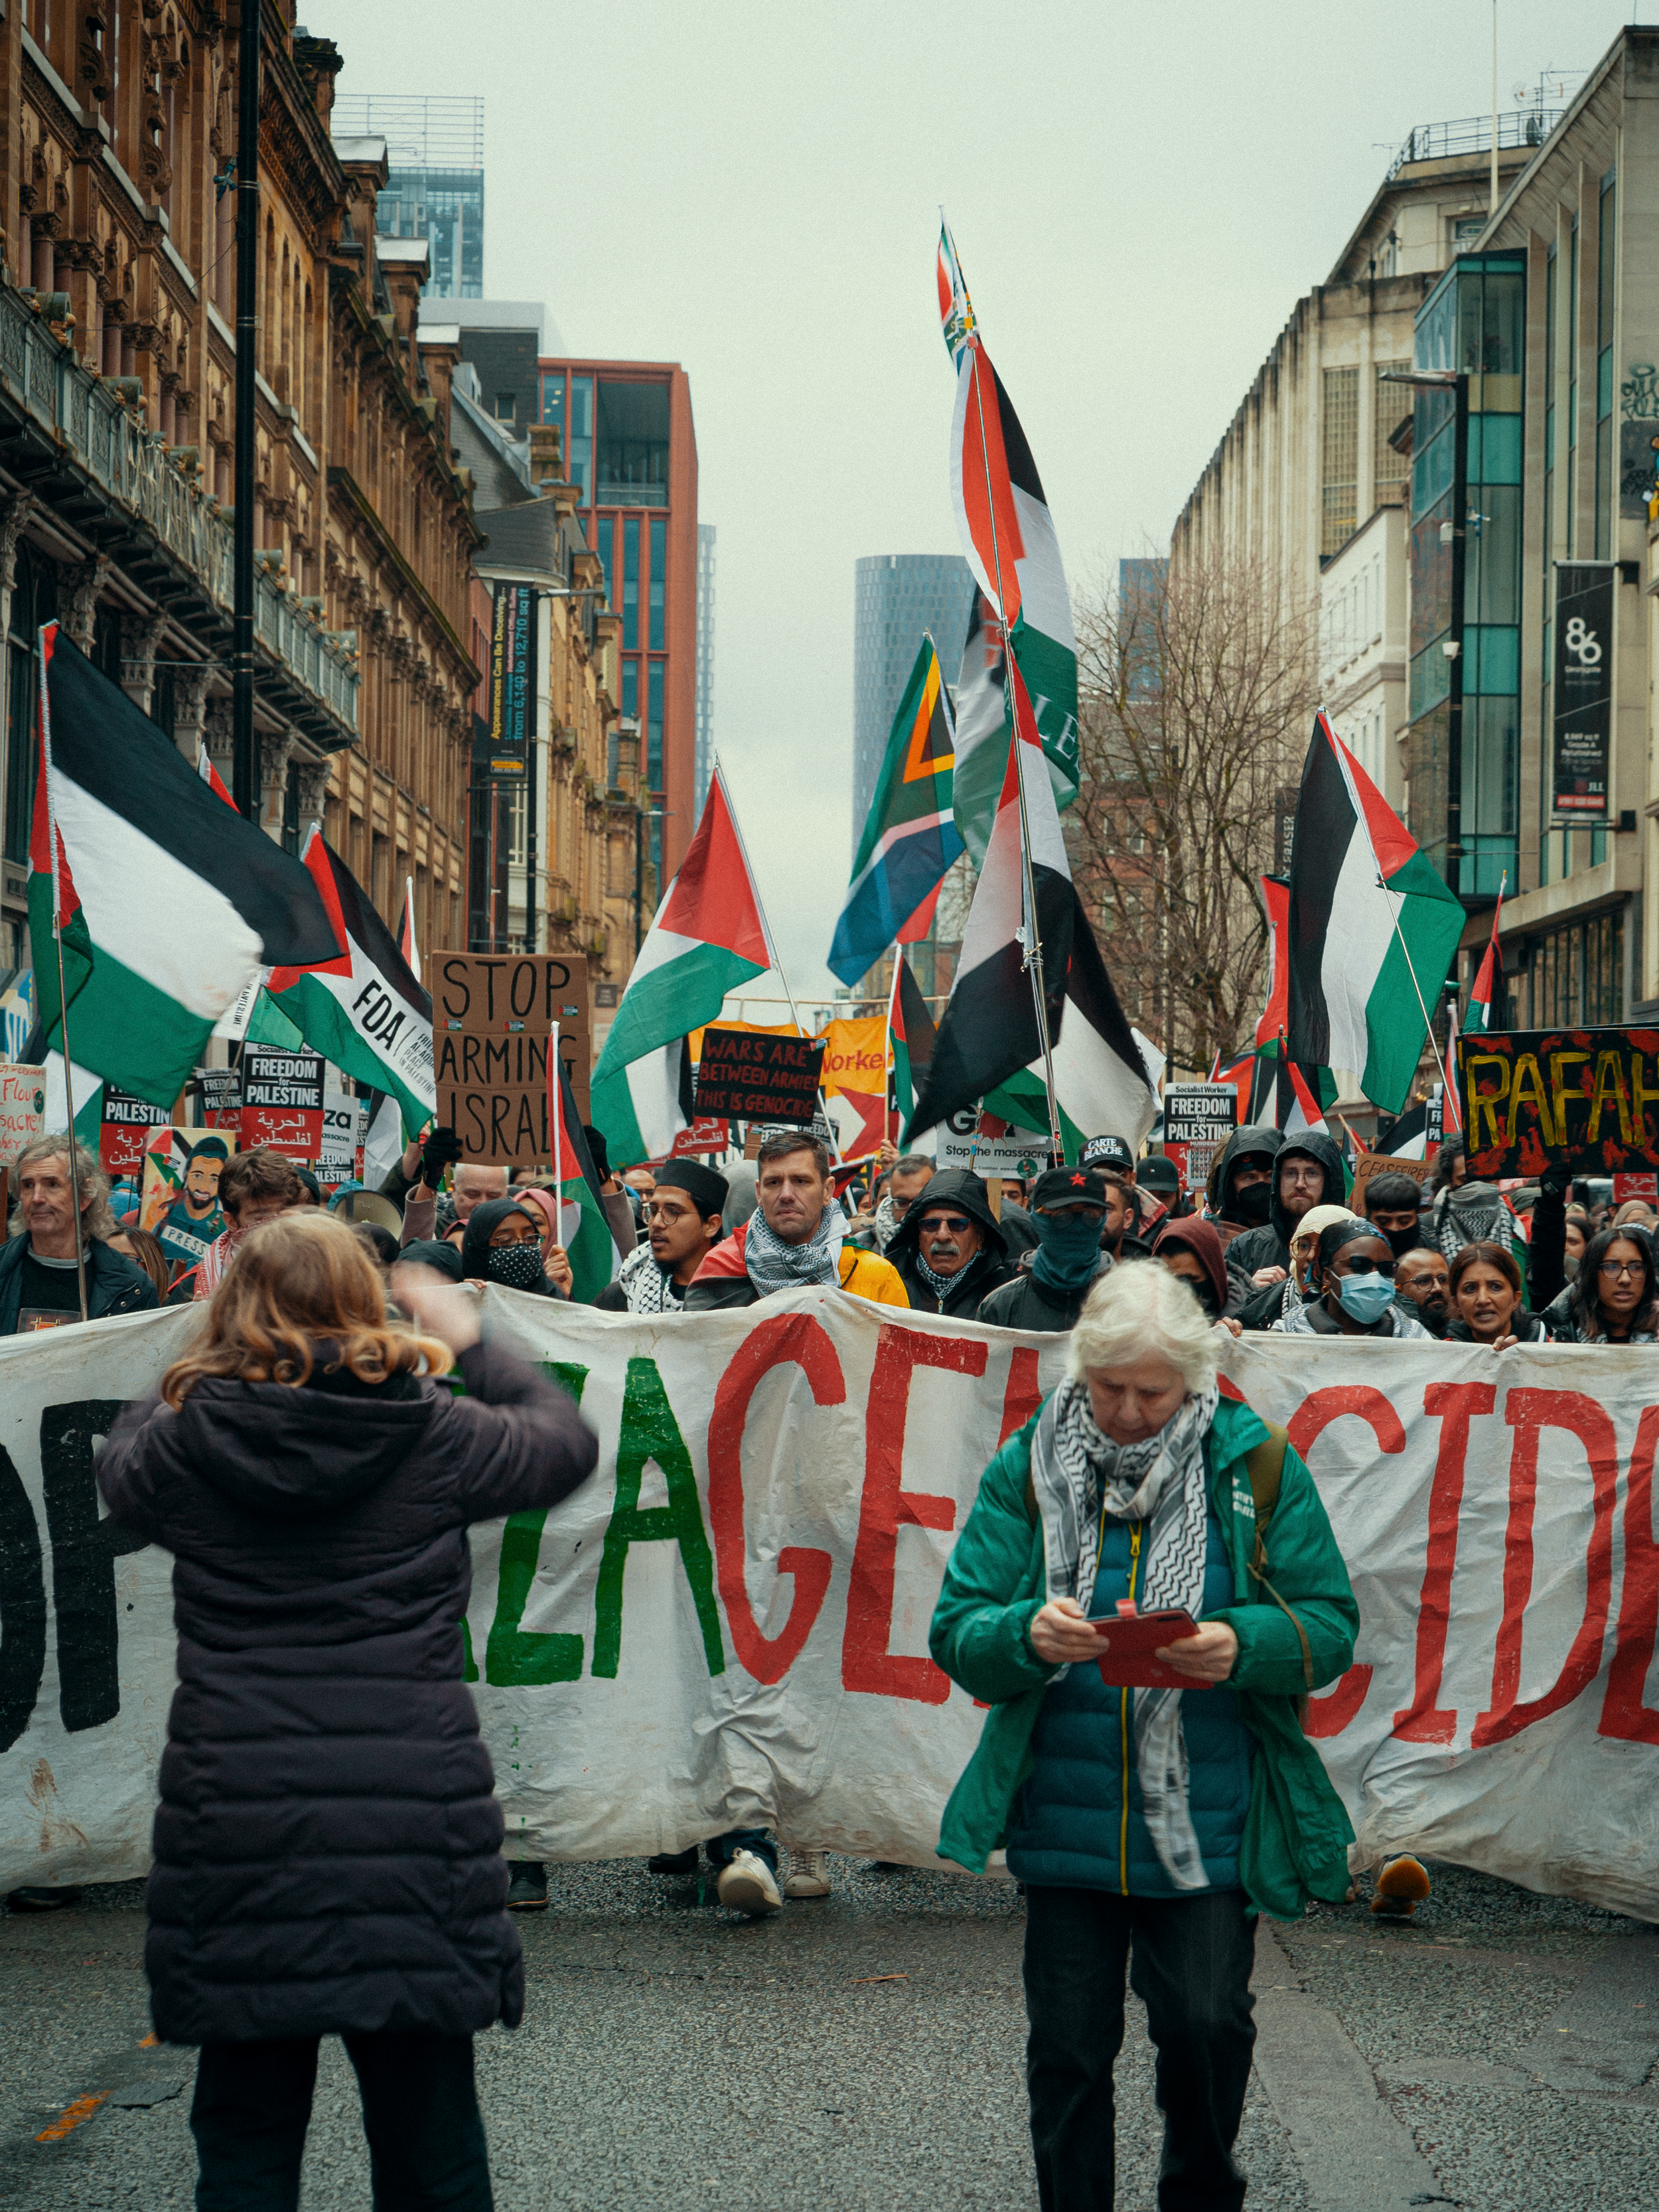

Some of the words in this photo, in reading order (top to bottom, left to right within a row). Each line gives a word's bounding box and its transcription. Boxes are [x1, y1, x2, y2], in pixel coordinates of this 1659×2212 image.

[518, 588, 529, 598] ft
[518, 600, 530, 615] sq
[494, 643, 503, 656] Be
[493, 658, 502, 677] Can
[514, 660, 526, 673] to
[514, 711, 524, 740] from
[443, 960, 570, 1021] STOP
[437, 1034, 578, 1084] ARMING
[705, 1037, 766, 1062] WARS
[768, 1044, 811, 1067] ARE
[251, 1058, 317, 1079] FREEDOM
[699, 1063, 769, 1086] BETWEEN
[770, 1070, 820, 1092] ARMIES
[2, 1077, 40, 1102] Flour
[203, 1078, 239, 1092] FREEDOM
[278, 1077, 290, 1086] for
[204, 1096, 242, 1110] PALESTINE
[246, 1084, 320, 1106] PALESTINE
[697, 1089, 727, 1109] THIS
[730, 1092, 744, 1112] IS
[745, 1094, 814, 1118] GENOCIDE
[1466, 1050, 1659, 1154] RAFAH
[106, 1102, 170, 1124] PALESTIN
[1171, 1098, 1230, 1116] FREEDOM
[257, 1111, 305, 1130] الحرية
[323, 1109, 352, 1130] za
[451, 1092, 551, 1157] ISRAE
[1196, 1114, 1206, 1124] for
[250, 1130, 311, 1147] لفلسطين
[322, 1132, 350, 1143] assacre
[676, 1131, 724, 1149] لفلسطين
[1088, 1138, 1117, 1150] CARTE
[315, 1153, 351, 1165] EEDOM
[946, 1145, 970, 1158] Stop
[975, 1146, 991, 1157] the
[994, 1147, 1048, 1159] massacre
[1084, 1146, 1123, 1161] BLANCHE
[315, 1170, 352, 1183] ALESTINE
[167, 1228, 207, 1255] PRESS
[461, 1357, 724, 1687] ZA
[707, 1313, 1659, 1749] GECIDE
